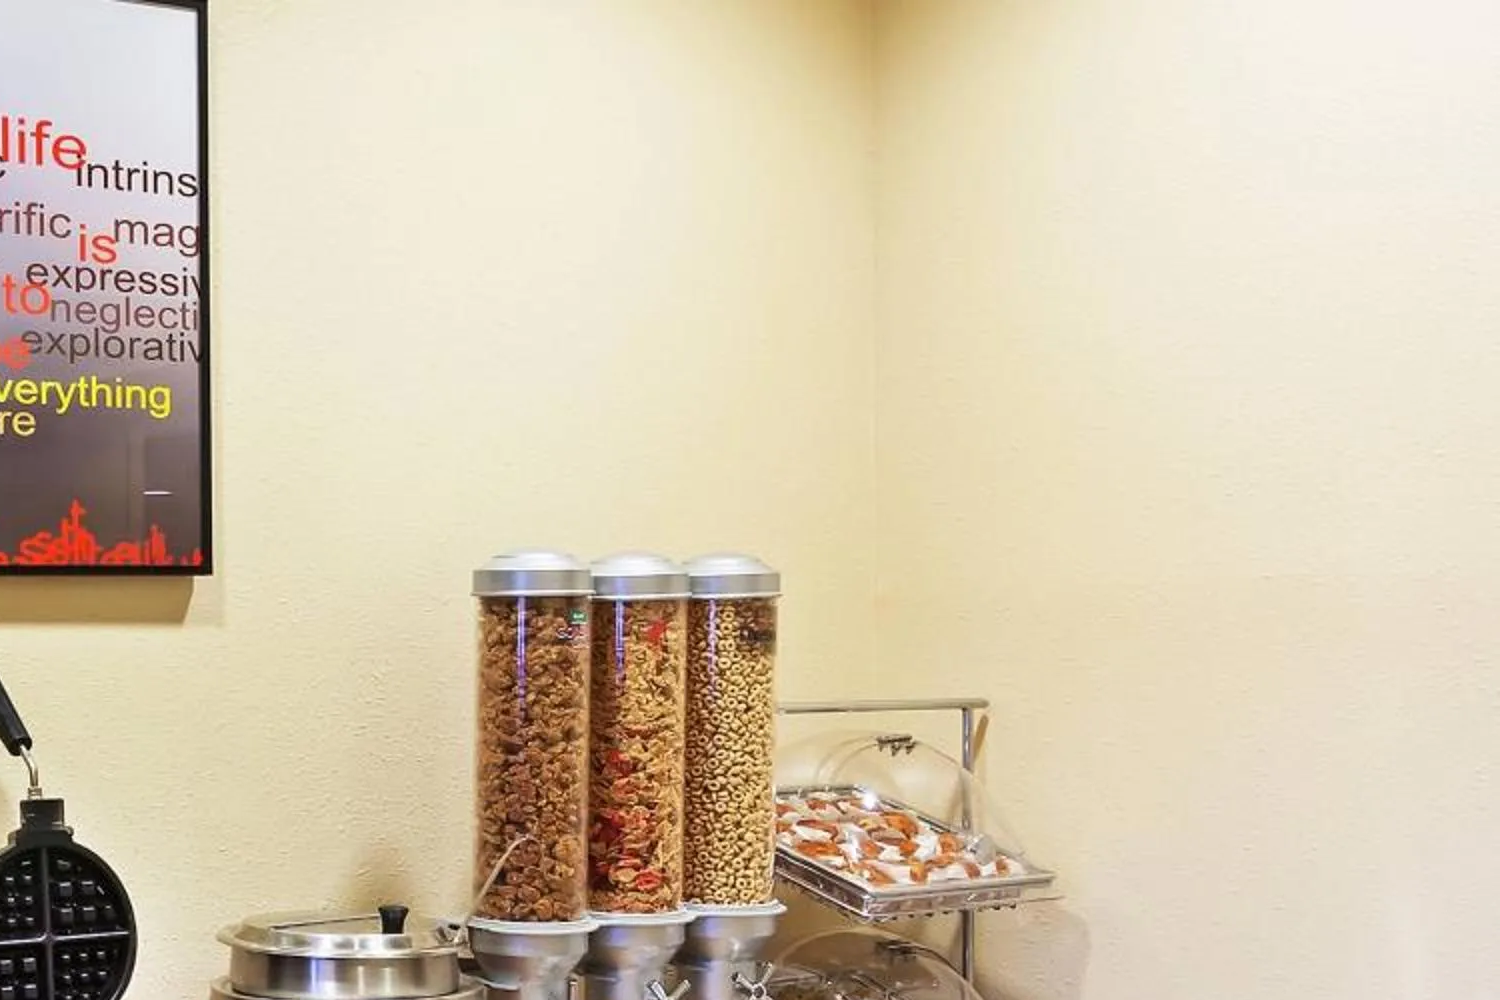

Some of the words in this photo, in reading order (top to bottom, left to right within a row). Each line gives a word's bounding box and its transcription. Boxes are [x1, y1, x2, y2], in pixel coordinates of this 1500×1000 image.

[0, 115, 87, 171] life
[79, 223, 118, 264] is
[113, 218, 200, 258] mag
[2, 273, 52, 316] to
